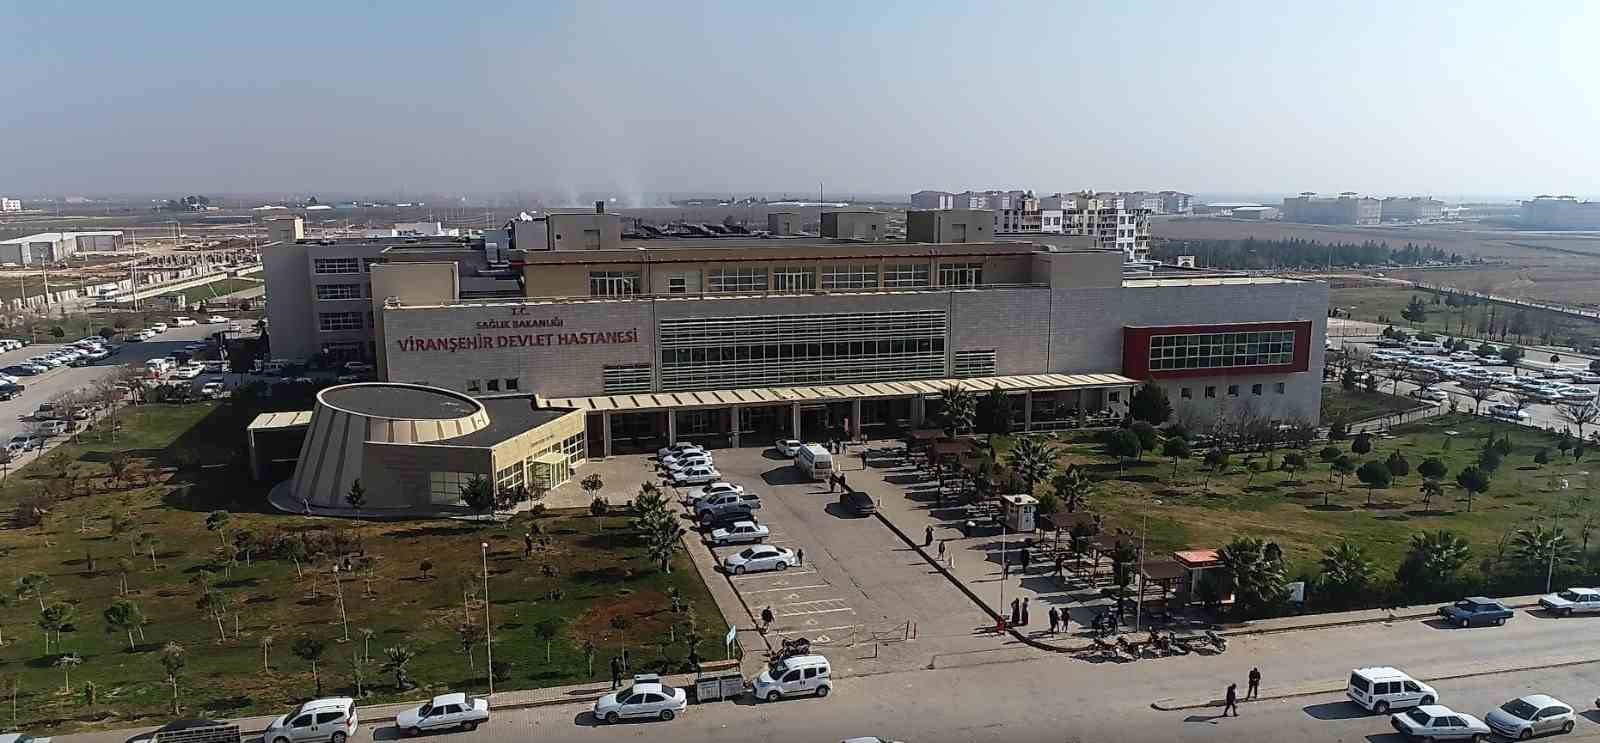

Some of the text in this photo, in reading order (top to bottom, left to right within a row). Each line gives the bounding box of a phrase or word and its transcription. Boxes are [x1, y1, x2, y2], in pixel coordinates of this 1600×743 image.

[476, 316, 564, 329] SAĞLIK BAKANLIĞI
[397, 328, 639, 353] VİRANŞEHİR DEVLET HASTANESİ
